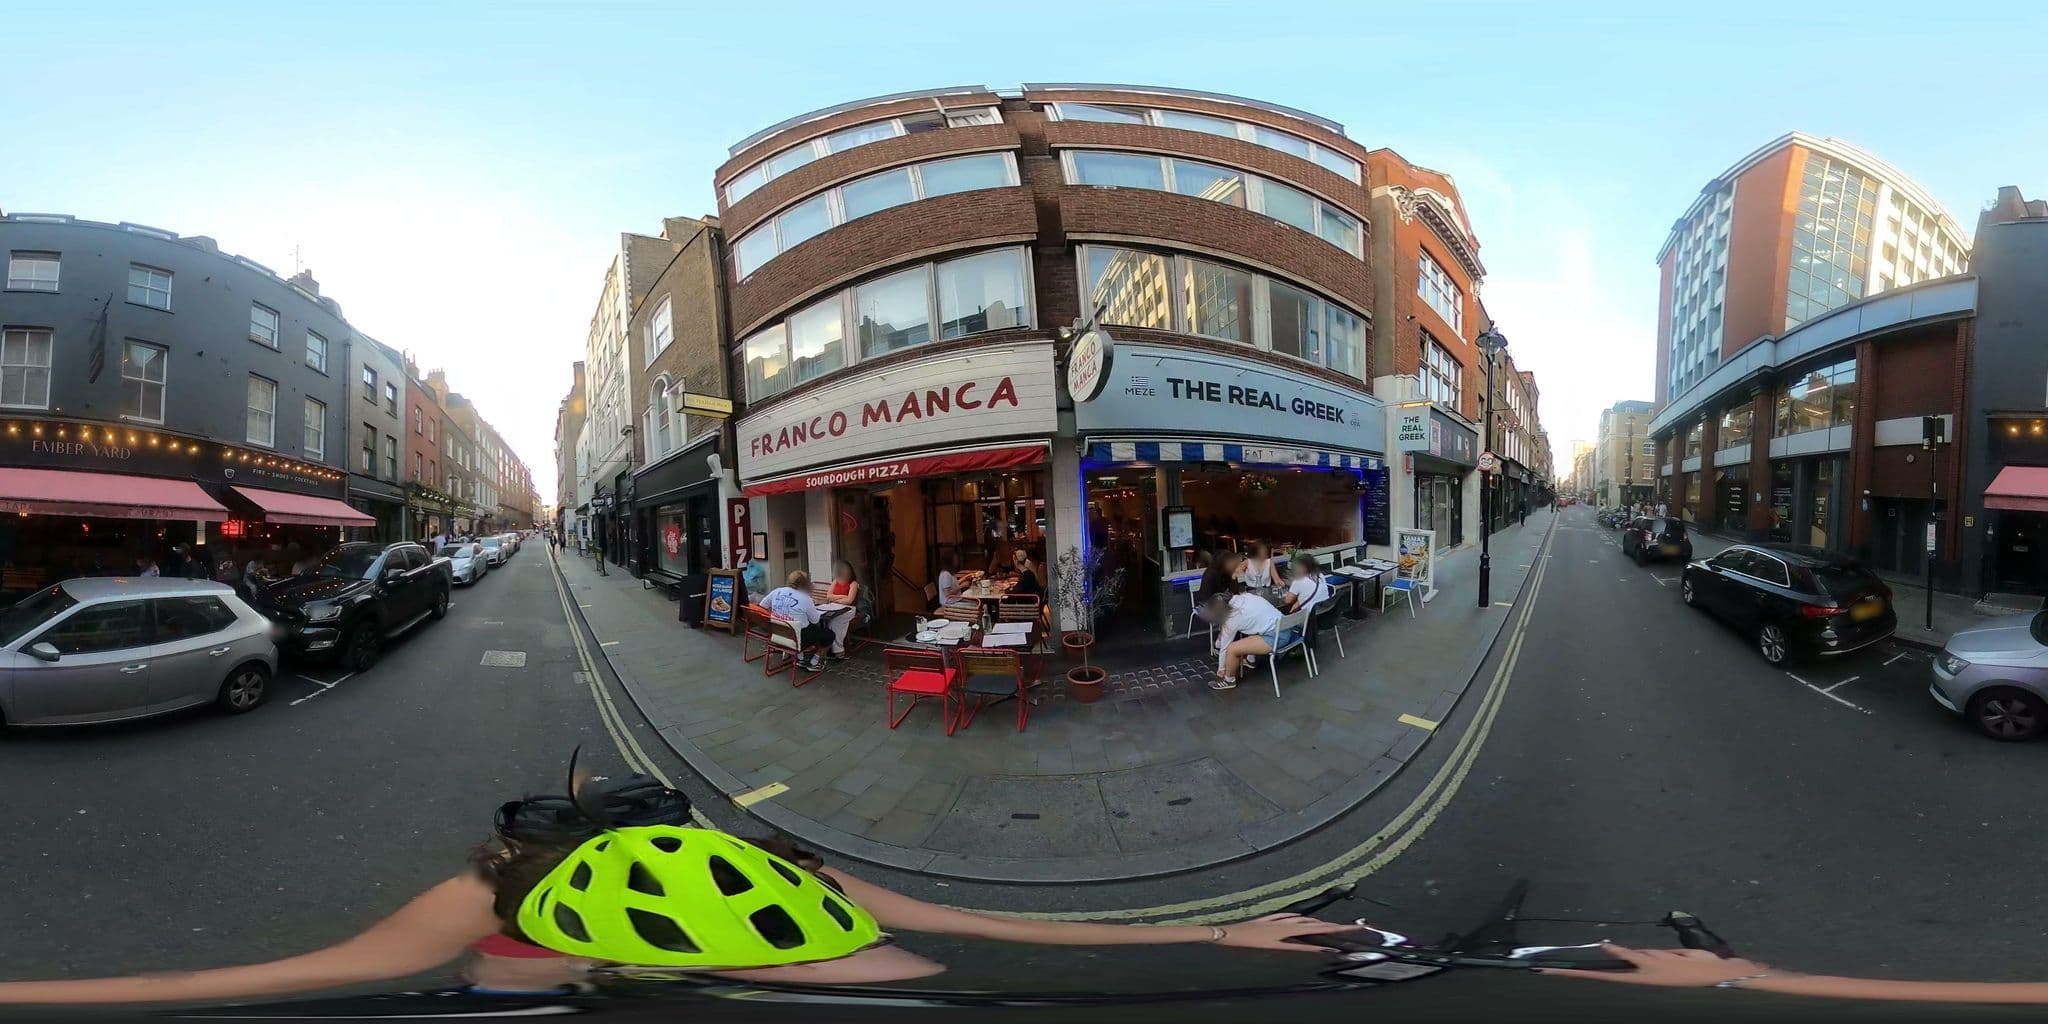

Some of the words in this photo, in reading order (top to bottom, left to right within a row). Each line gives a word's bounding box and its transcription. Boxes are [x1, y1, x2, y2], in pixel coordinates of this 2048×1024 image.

[1071, 341, 1096, 377] FRANCO
[1074, 360, 1098, 392] MANCA
[1125, 387, 1156, 396] MEZE
[1166, 377, 1222, 402] THE
[1228, 385, 1287, 412] REAL
[1291, 397, 1345, 424] GREEK
[751, 411, 847, 457] FRANCO
[862, 376, 1018, 427] MANCA
[1403, 416, 1420, 424] THE
[1398, 432, 1426, 441] GREEK
[1401, 424, 1423, 433] REAL
[32, 440, 84, 456] EMBER
[91, 443, 131, 460] YARD
[806, 469, 865, 488] SOURDOUGH
[868, 463, 910, 479] PIZZA
